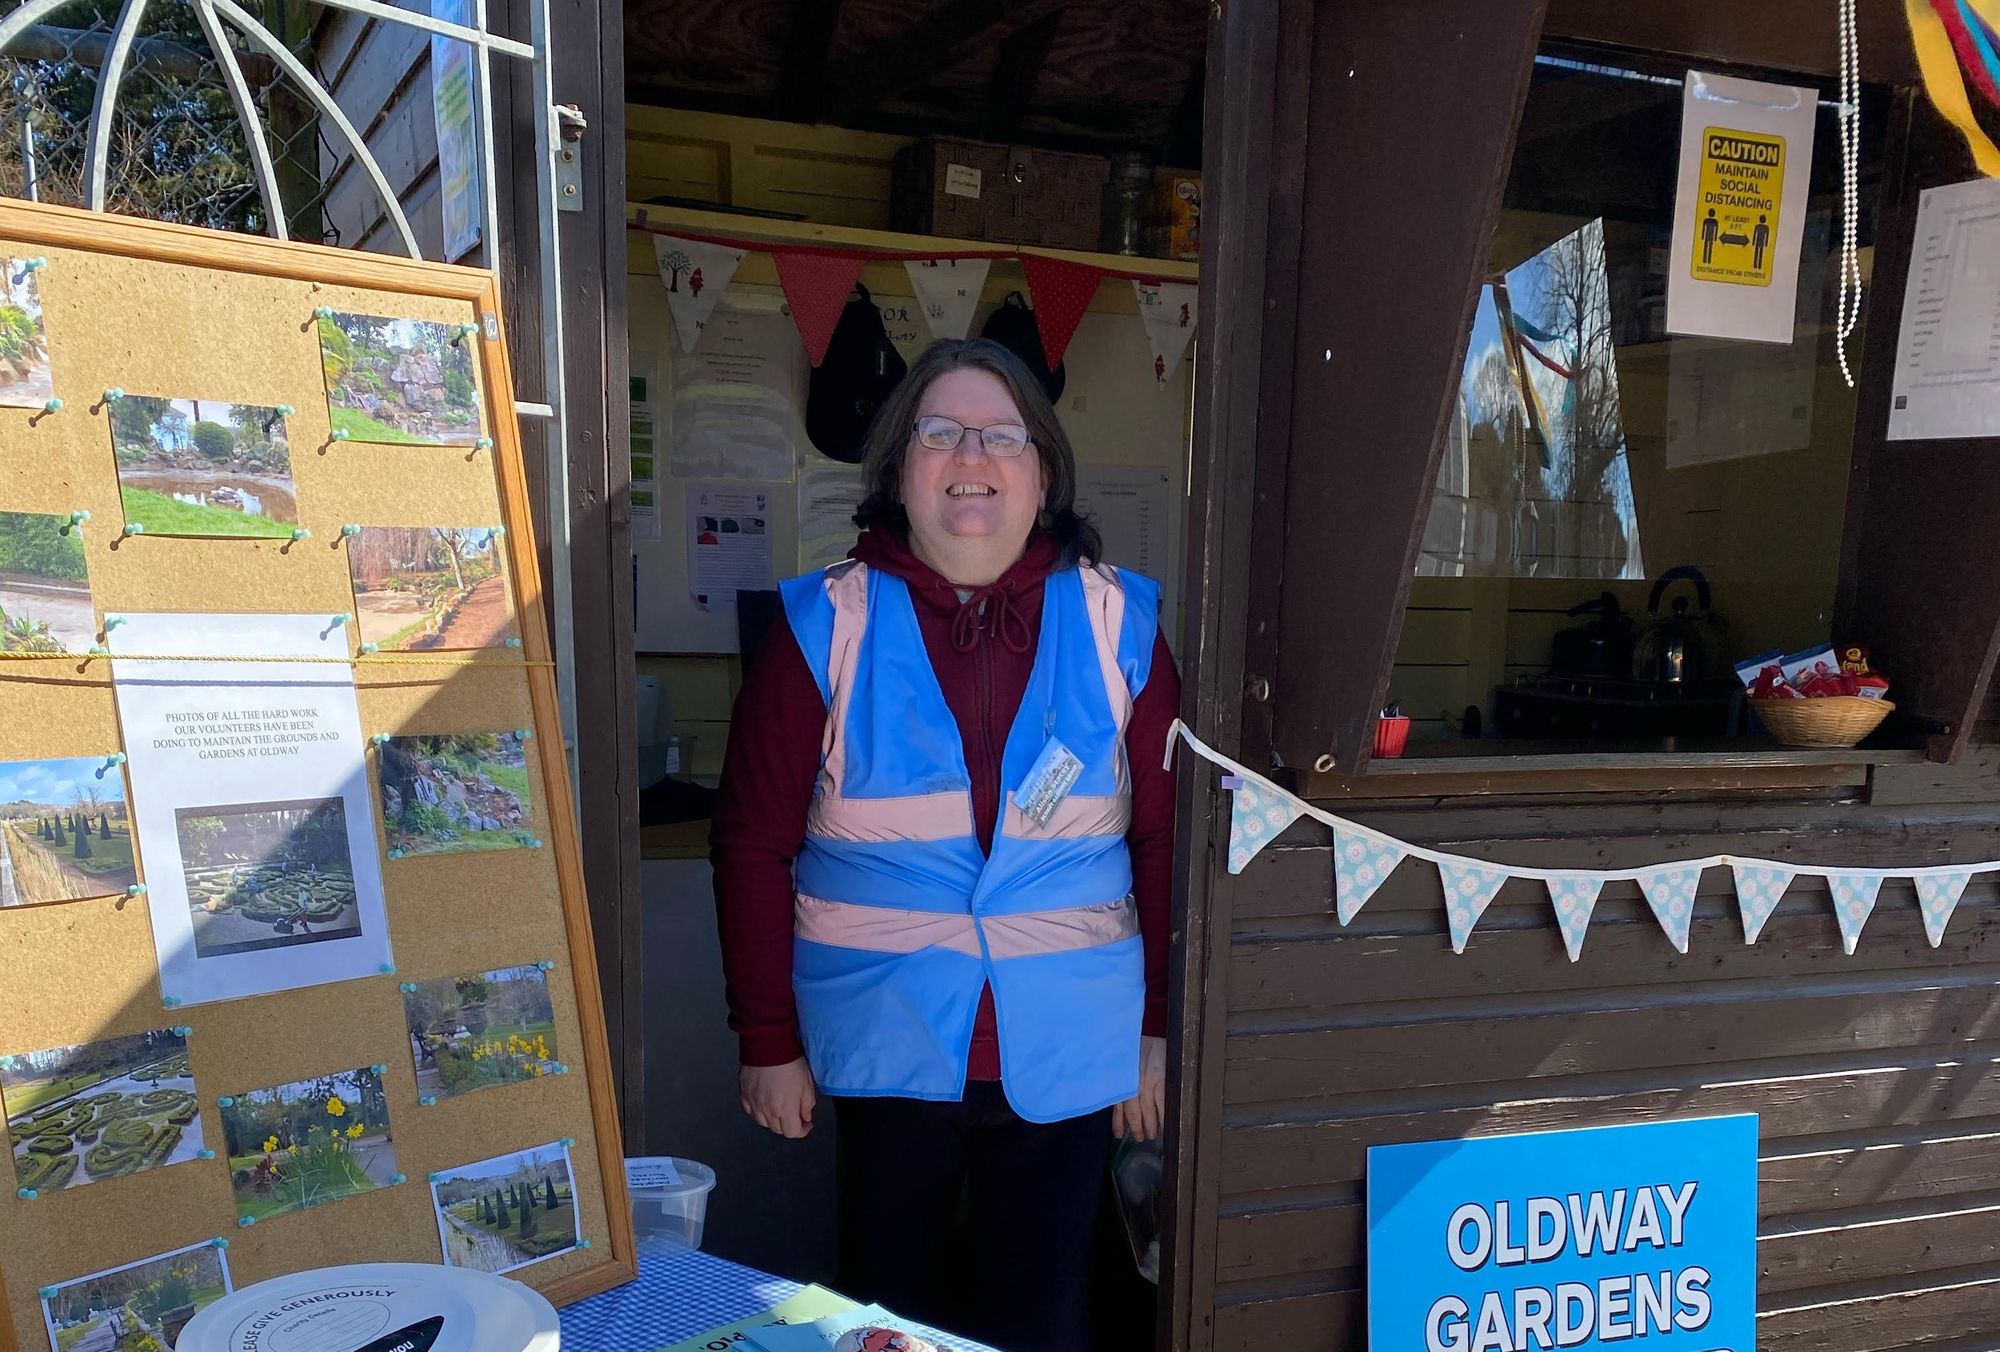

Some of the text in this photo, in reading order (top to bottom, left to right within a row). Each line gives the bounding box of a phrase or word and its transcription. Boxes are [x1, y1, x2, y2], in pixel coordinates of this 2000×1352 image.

[1710, 138, 1778, 164] CAUTION
[1715, 163, 1769, 180] MAINTAIN
[1720, 179, 1761, 194] SOCIAL
[1705, 192, 1773, 210] DISTANCING
[1724, 214, 1751, 223] AT LEAST
[1696, 265, 1766, 279] DISTANCE FROM OTHERS
[165, 708, 319, 723] PHOTOS OF ALL THE HARD WORK
[174, 721, 314, 735] OUR VOLUNTEERS HAVE BEEN
[153, 732, 339, 749] DOING TO MAINTAIN THE GROUNDS AND
[198, 746, 300, 760] GARDENS AT OLDWAY
[1446, 1181, 1699, 1272] OLDWAY
[252, 1310, 282, 1330] GIVE
[281, 1289, 397, 1313] GENEROUSLY
[1425, 1265, 1712, 1352] GARDENS
